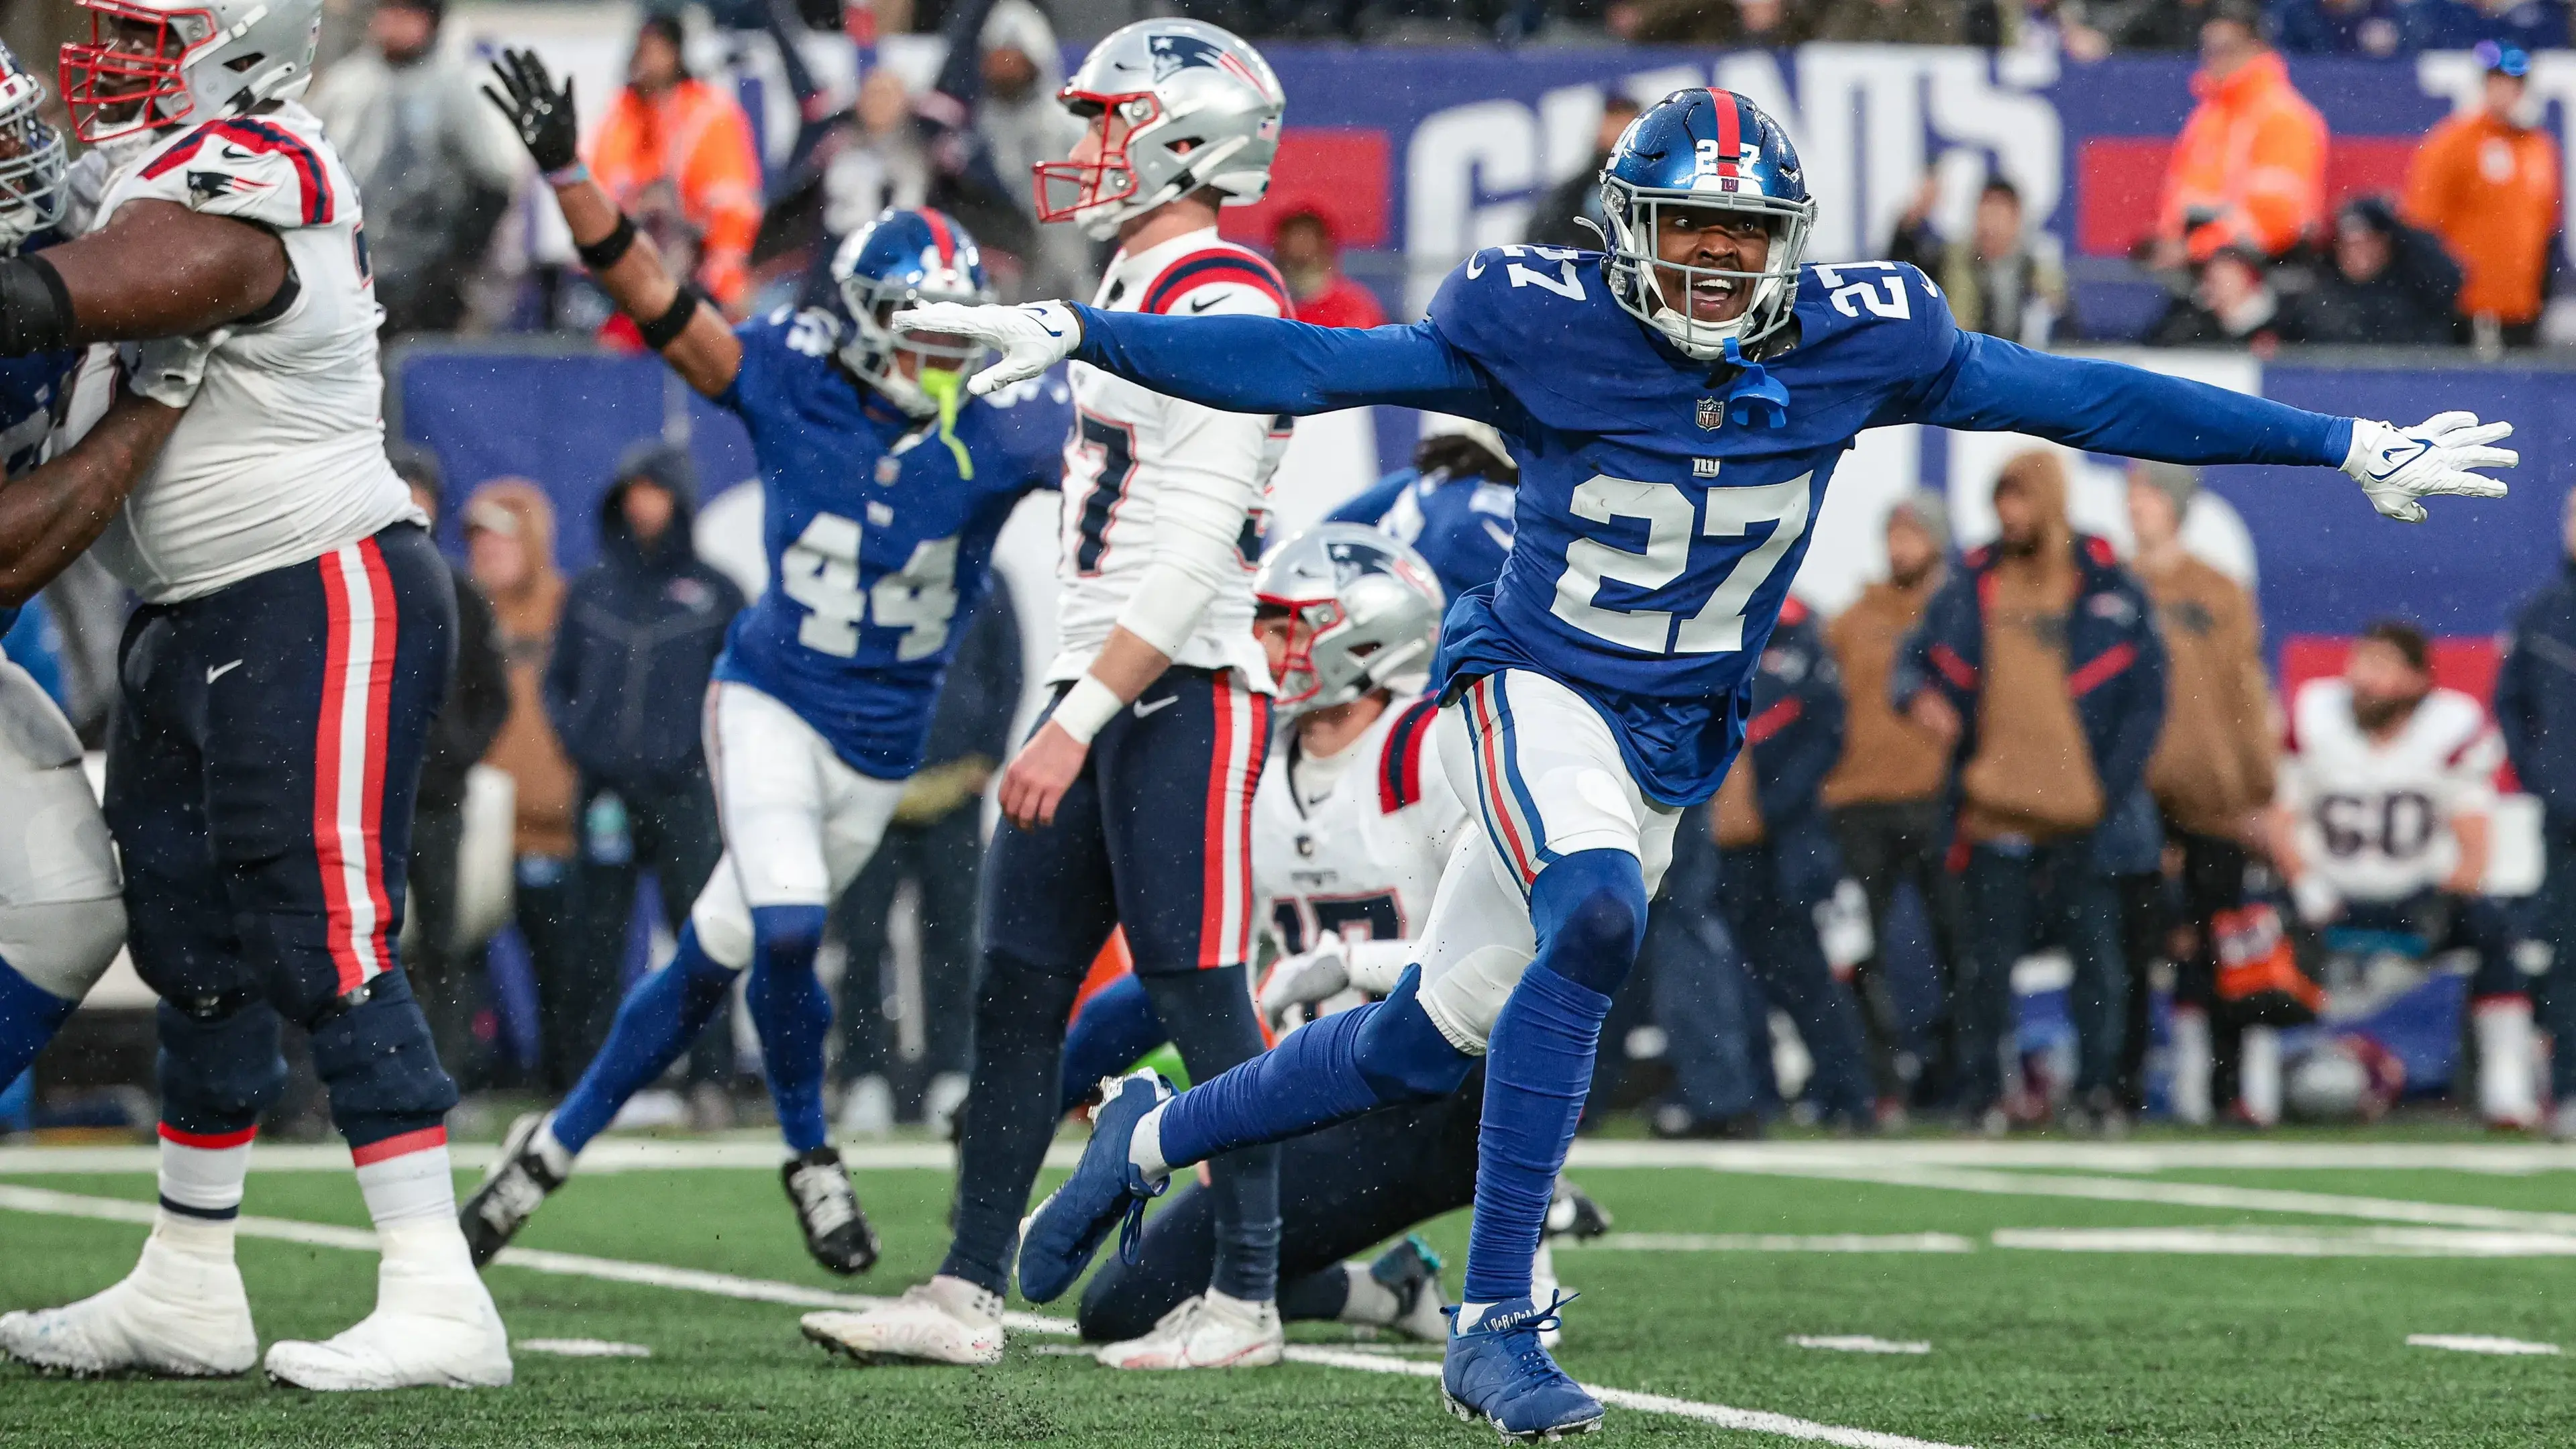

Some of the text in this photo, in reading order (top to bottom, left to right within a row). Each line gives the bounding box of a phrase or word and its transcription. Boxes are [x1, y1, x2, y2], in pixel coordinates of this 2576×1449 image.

[1405, 43, 2064, 322] GINTS
[1695, 139, 1760, 178] 27
[1497, 244, 1587, 301] 27
[1810, 260, 1911, 320] 27
[1699, 412, 1720, 426] NFL
[1070, 410, 1139, 578] 7
[782, 512, 960, 661] 44
[1550, 470, 1813, 654] 27
[2316, 789, 2436, 859] 60
